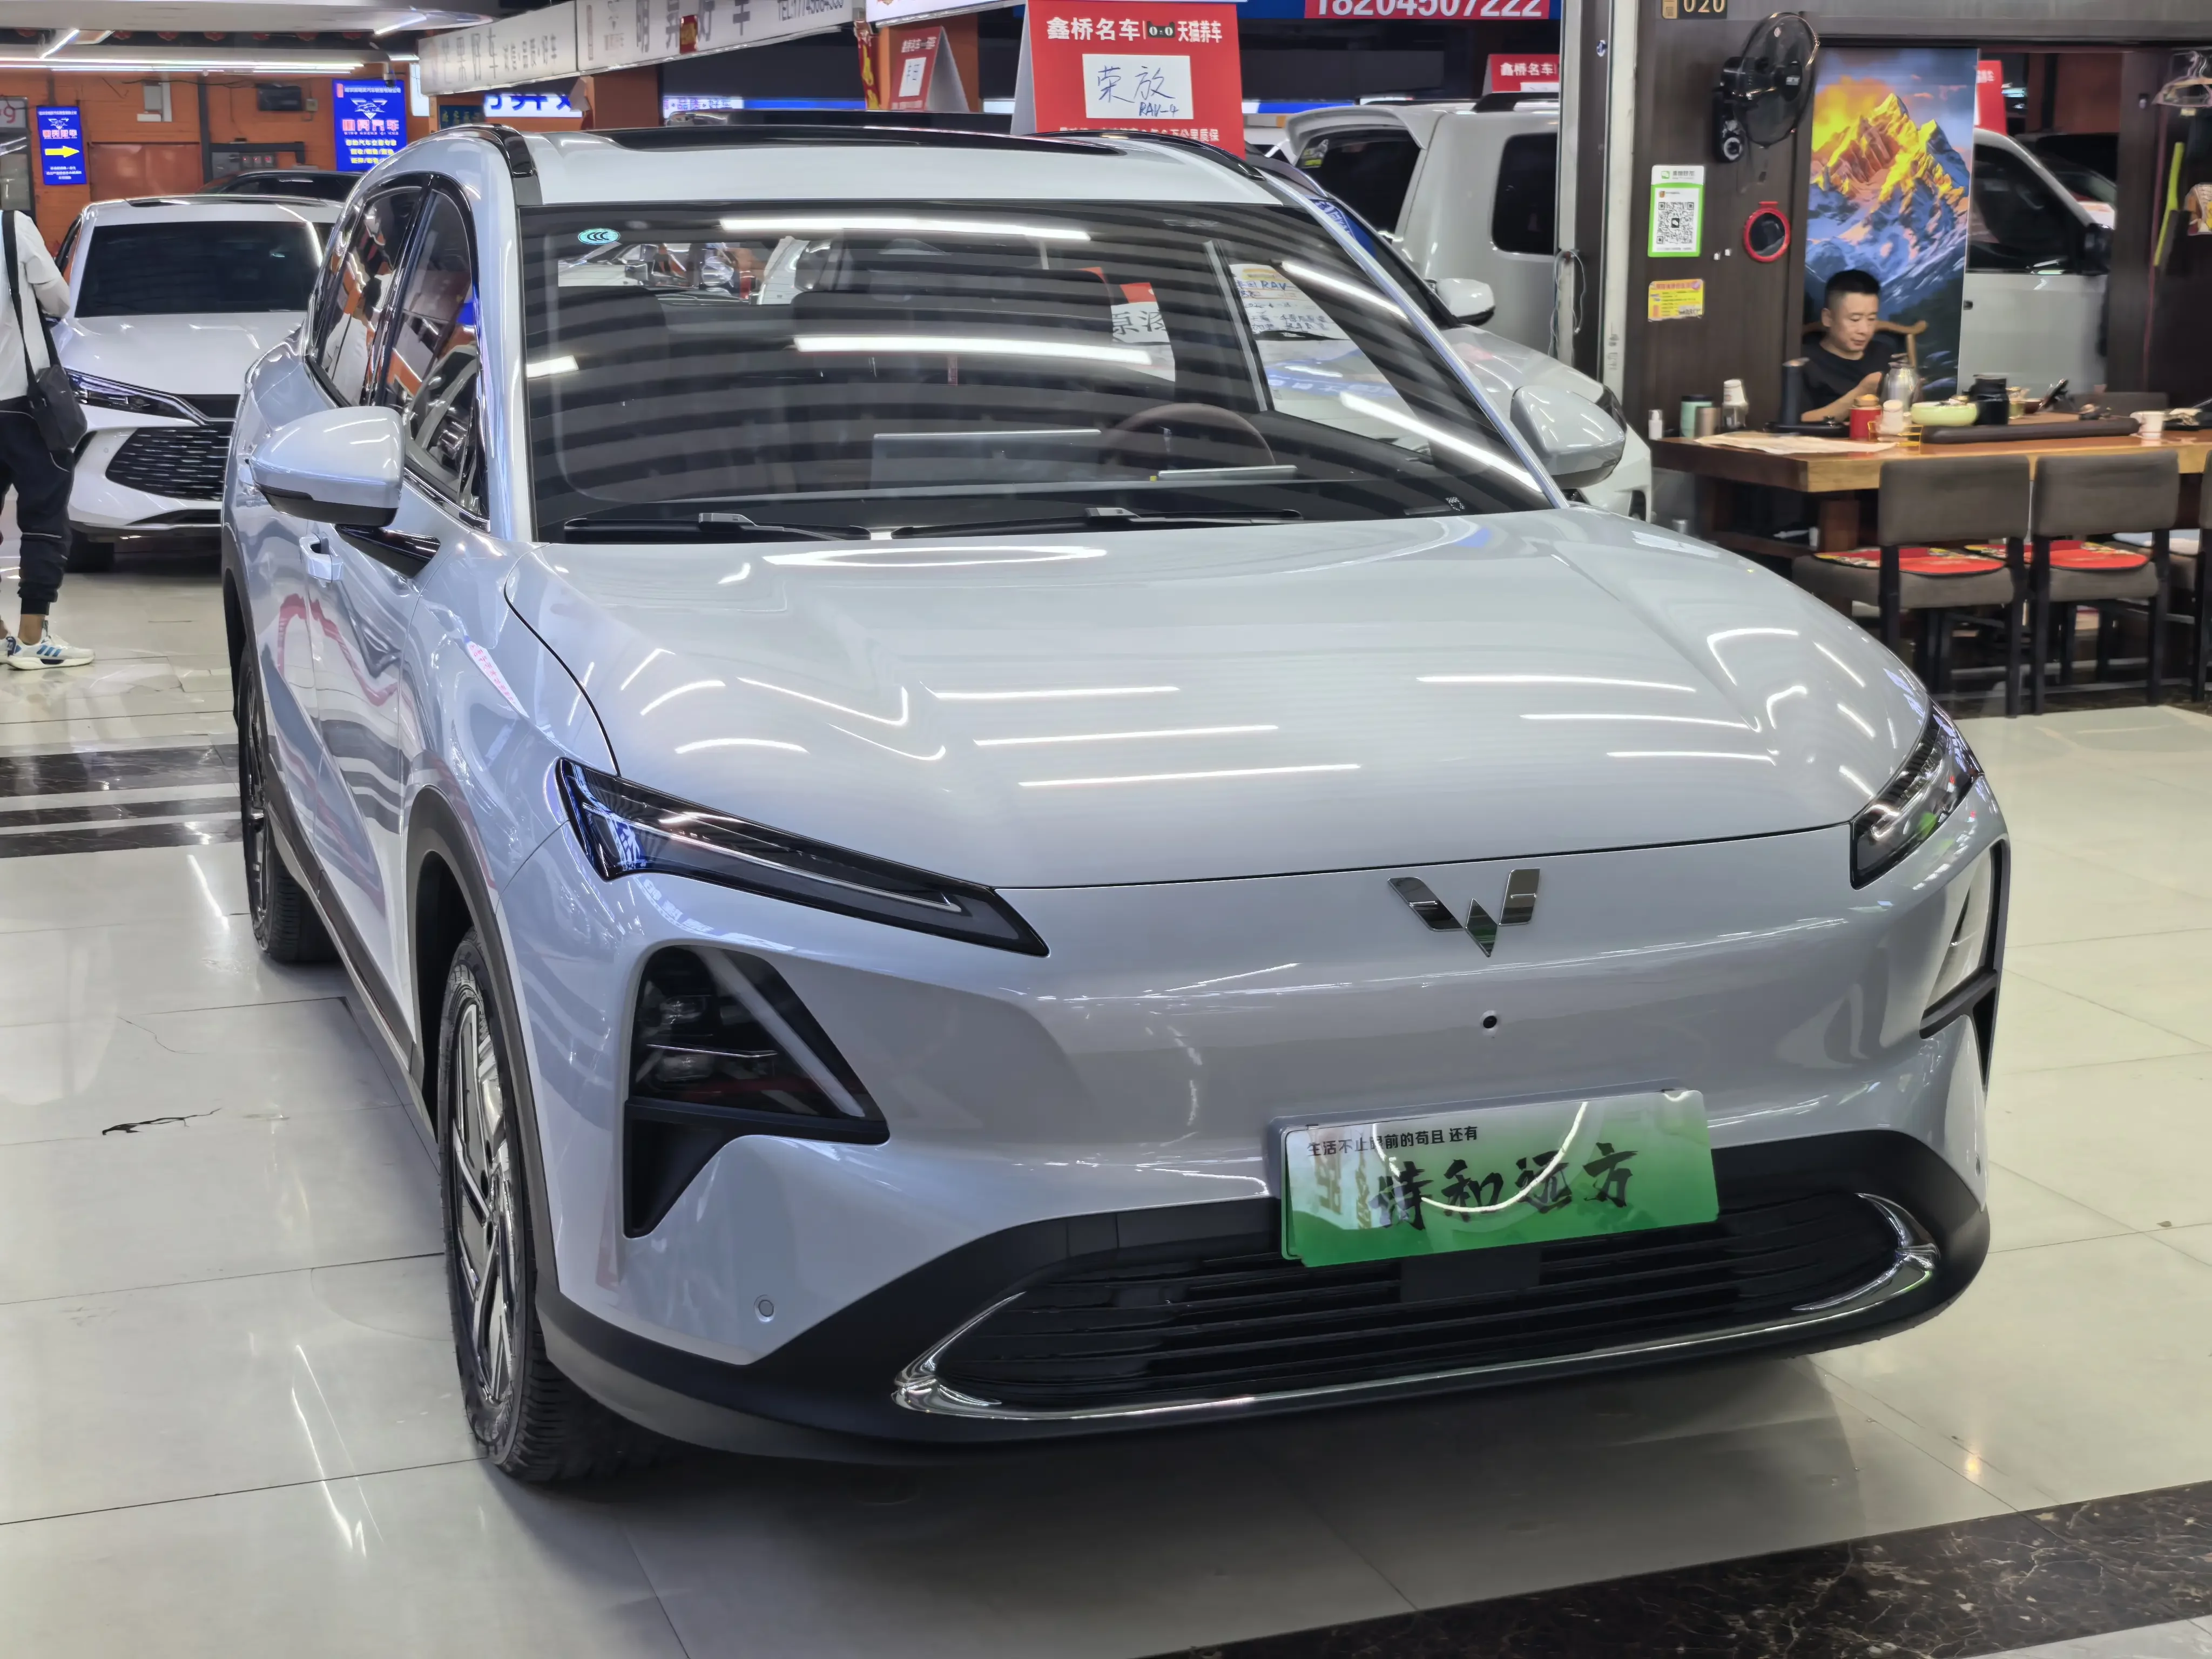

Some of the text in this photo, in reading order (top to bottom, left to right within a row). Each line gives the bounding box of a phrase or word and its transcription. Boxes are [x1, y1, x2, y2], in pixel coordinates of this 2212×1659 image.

[1047, 17, 1141, 41] 鑫桥名车
[1097, 65, 1176, 103] 荣放
[1449, 1126, 1478, 1142] 还有
[1368, 1142, 1638, 1231] 诗和远方
